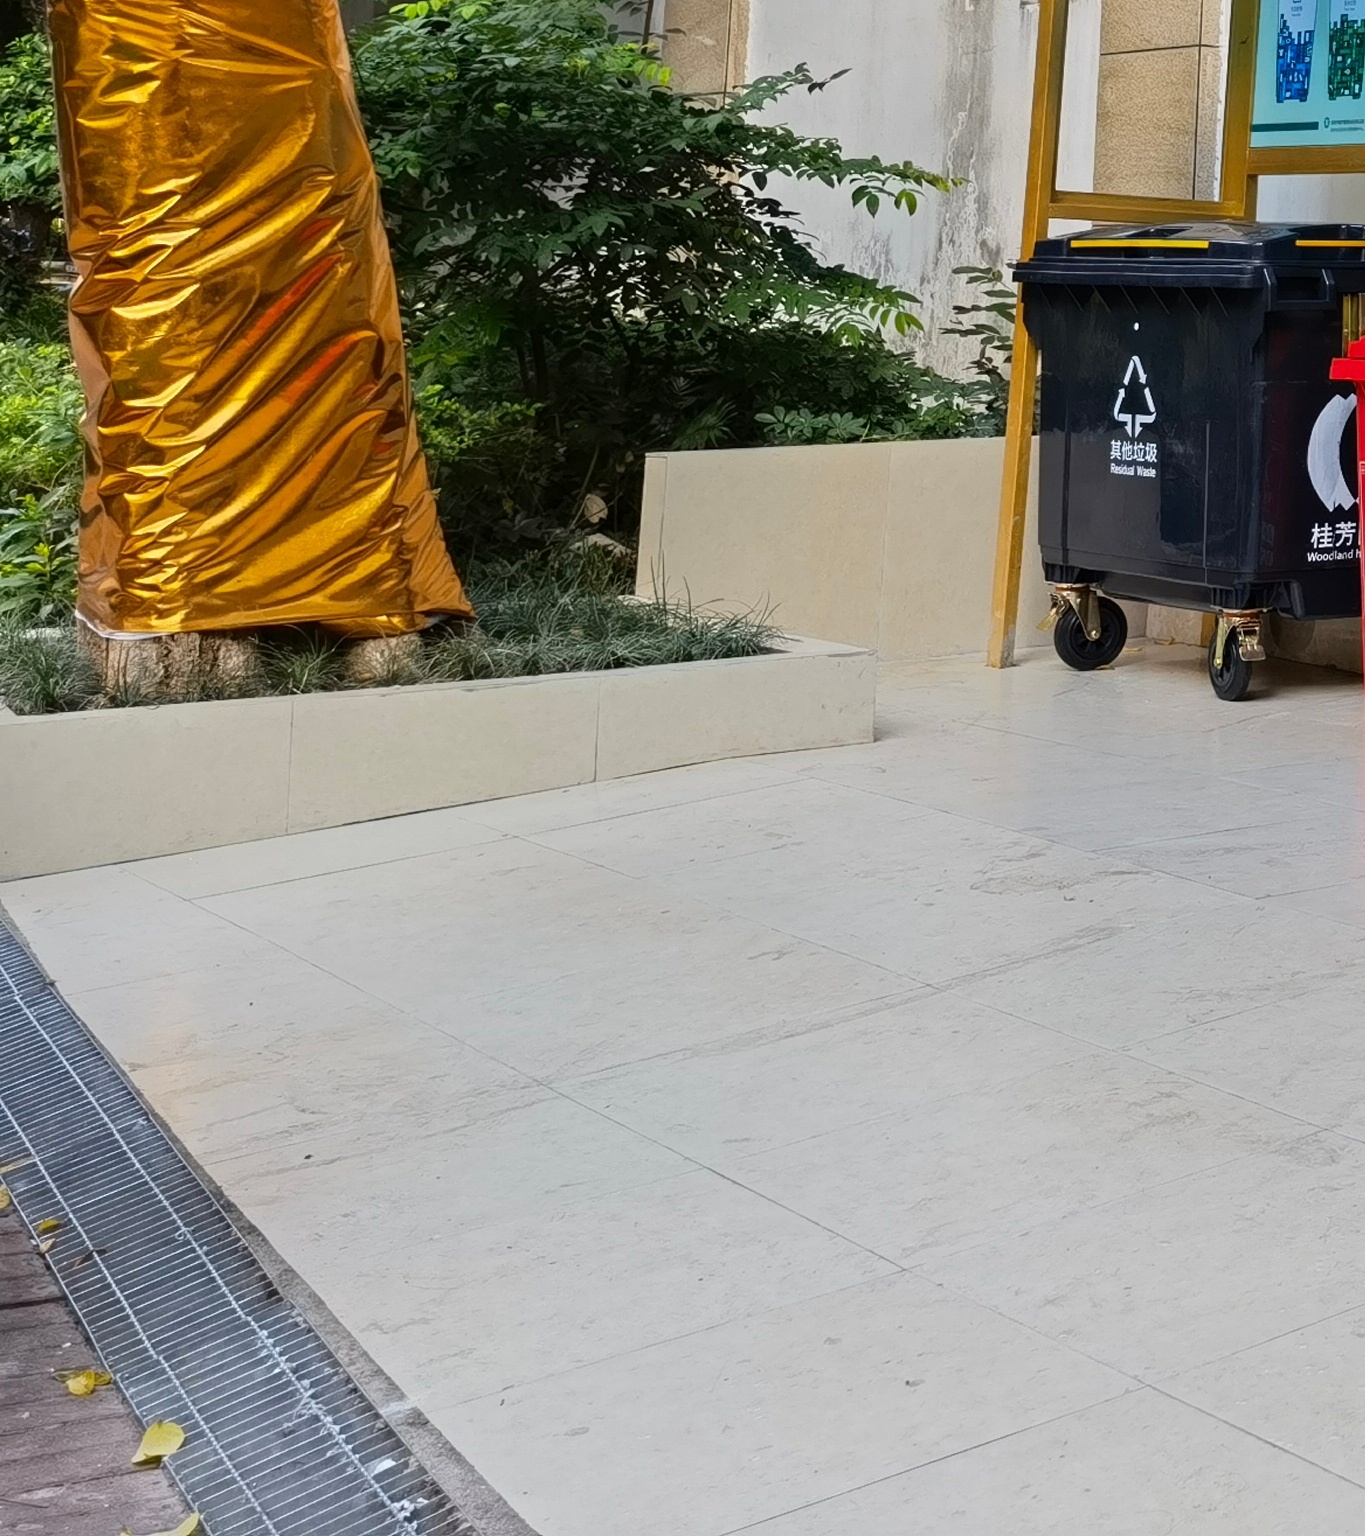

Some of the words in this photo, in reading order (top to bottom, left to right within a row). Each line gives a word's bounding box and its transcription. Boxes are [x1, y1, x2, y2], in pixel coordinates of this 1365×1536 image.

[1110, 439, 1158, 463] 其他垃圾
[1110, 463, 1135, 476] Residual
[1136, 465, 1157, 478] Waste
[1310, 521, 1360, 549] 桂芳
[1307, 549, 1354, 563] Woodland
